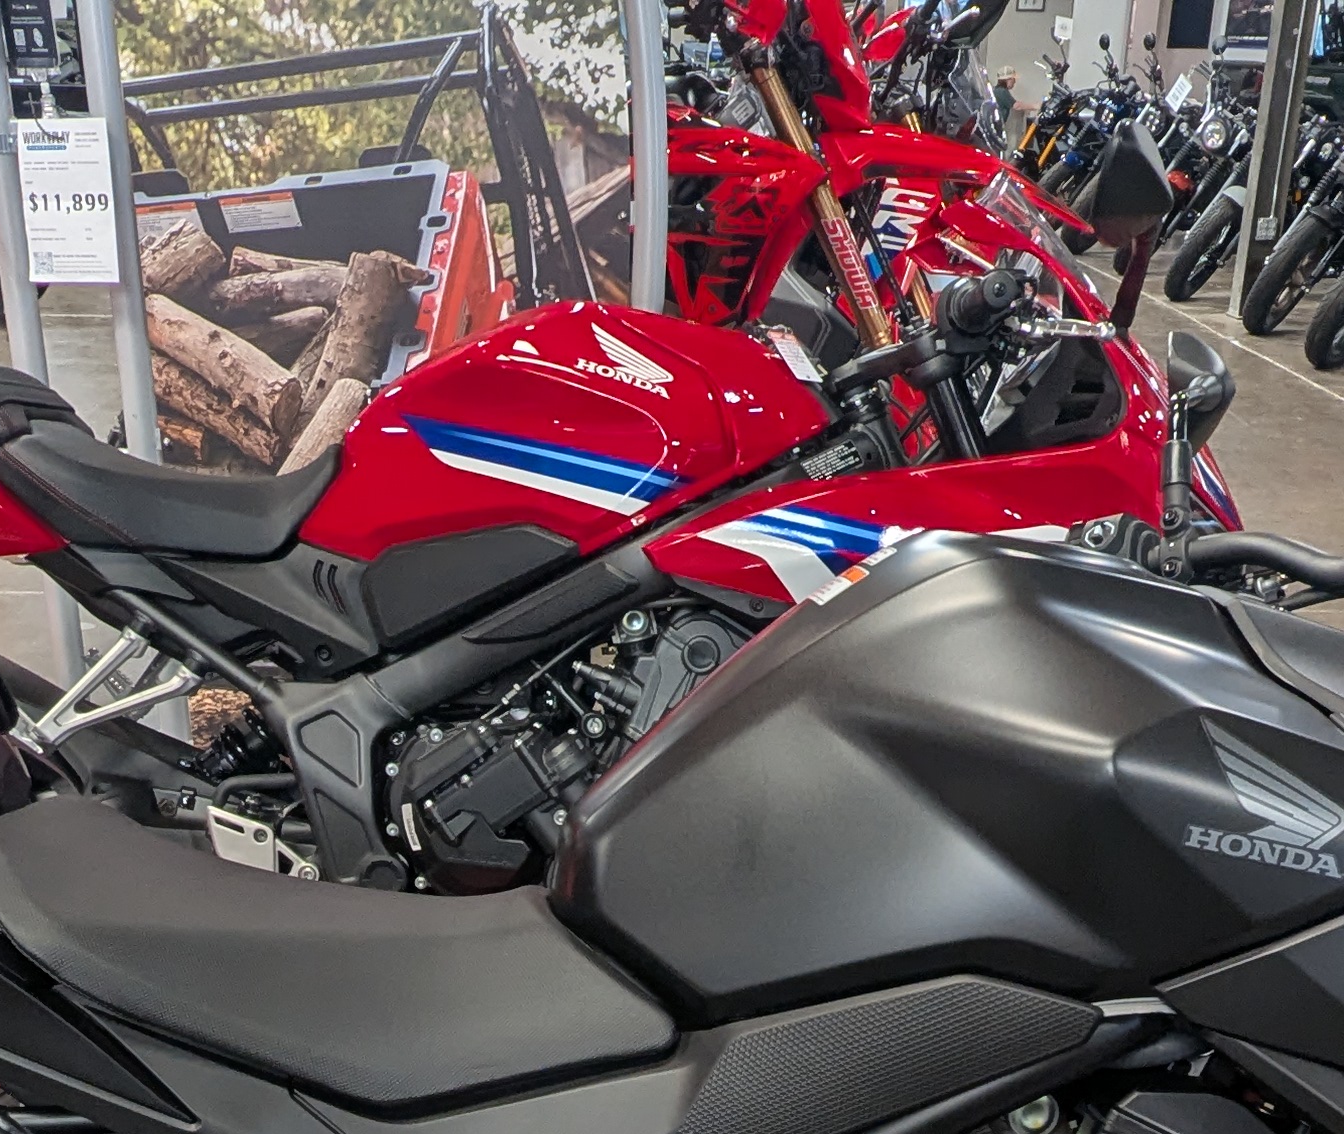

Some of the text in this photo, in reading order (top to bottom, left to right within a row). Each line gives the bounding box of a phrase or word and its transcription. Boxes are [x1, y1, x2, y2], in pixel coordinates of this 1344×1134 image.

[29, 192, 109, 214] $11,899
[574, 357, 670, 400] HONDA
[1184, 824, 1344, 879] HONDA
